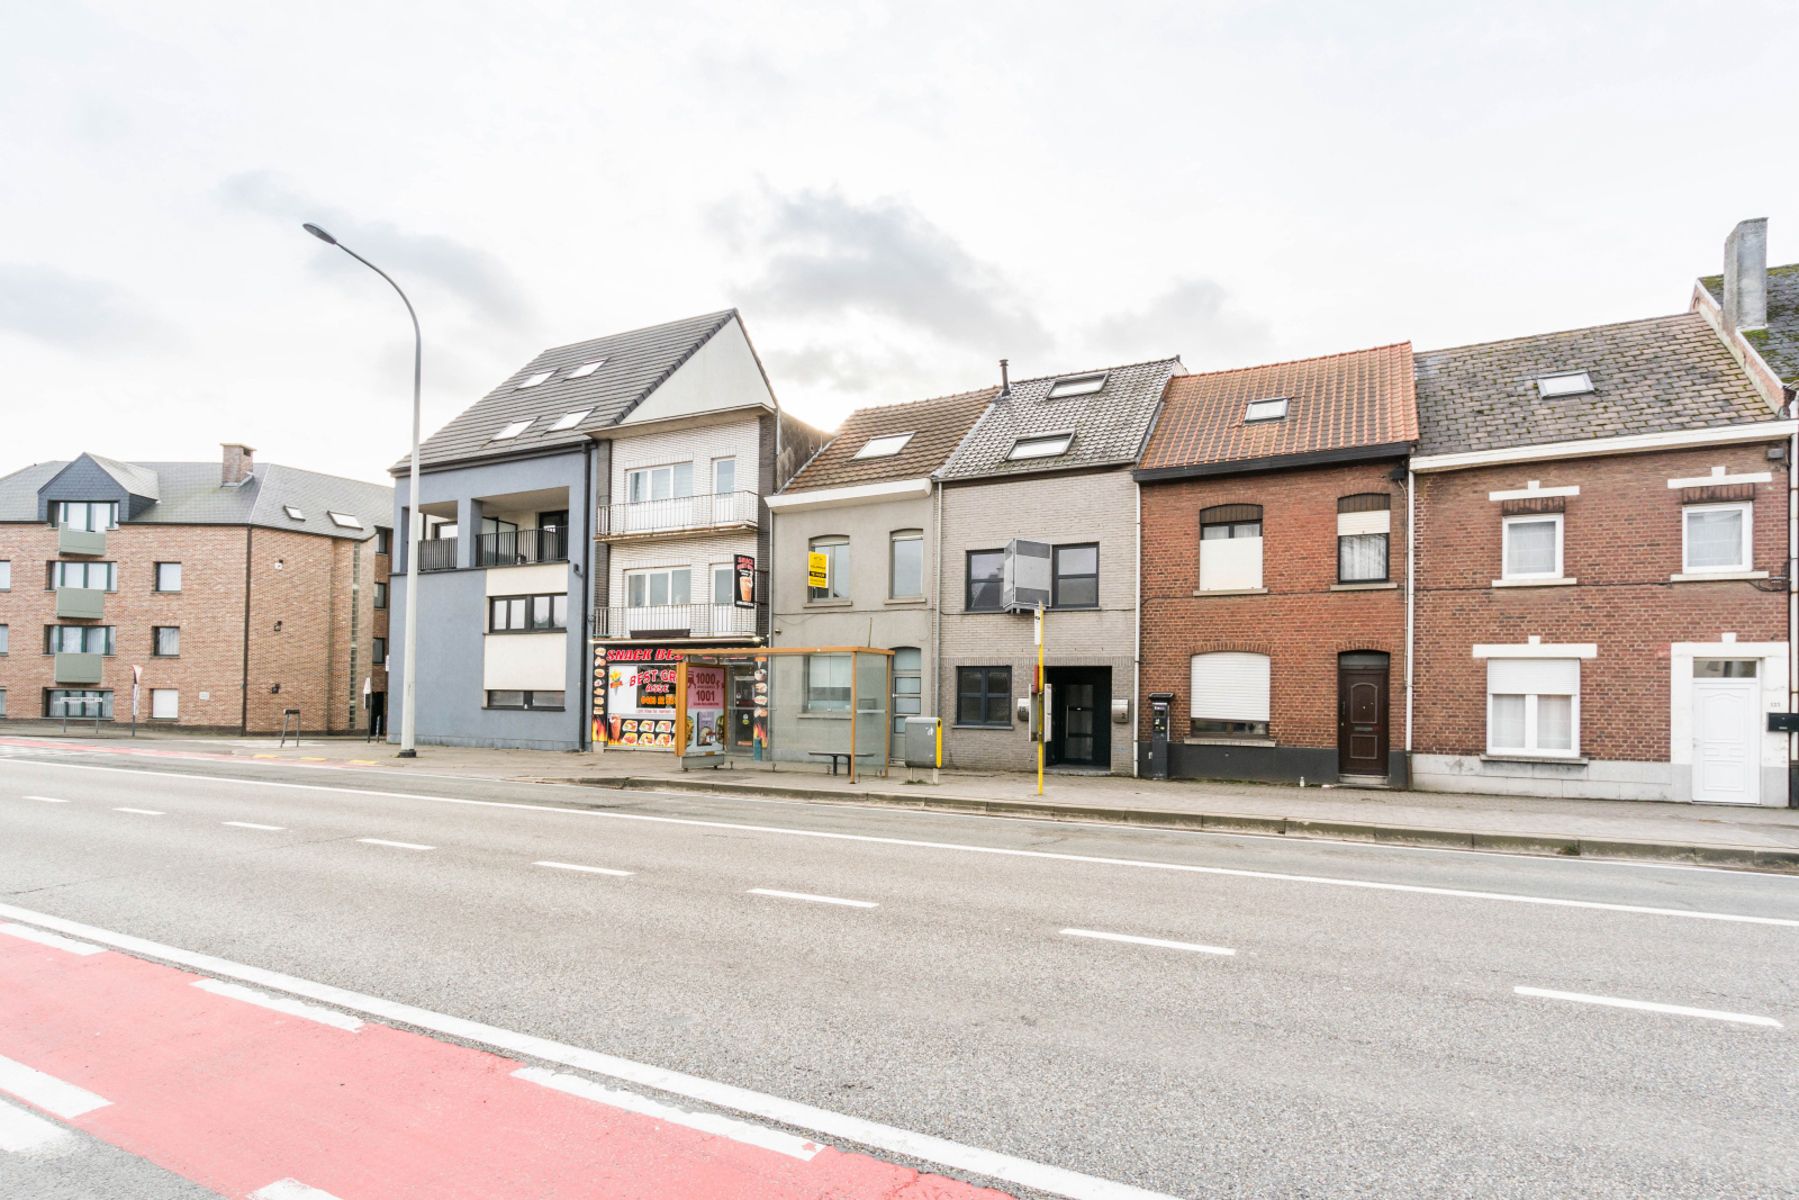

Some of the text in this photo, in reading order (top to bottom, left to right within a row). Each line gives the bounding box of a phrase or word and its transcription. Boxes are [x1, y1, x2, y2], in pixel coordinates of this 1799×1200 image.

[606, 649, 653, 661] SNACK
[629, 669, 658, 687] BEST
[696, 672, 716, 685] 1000
[696, 689, 715, 702] 1001
